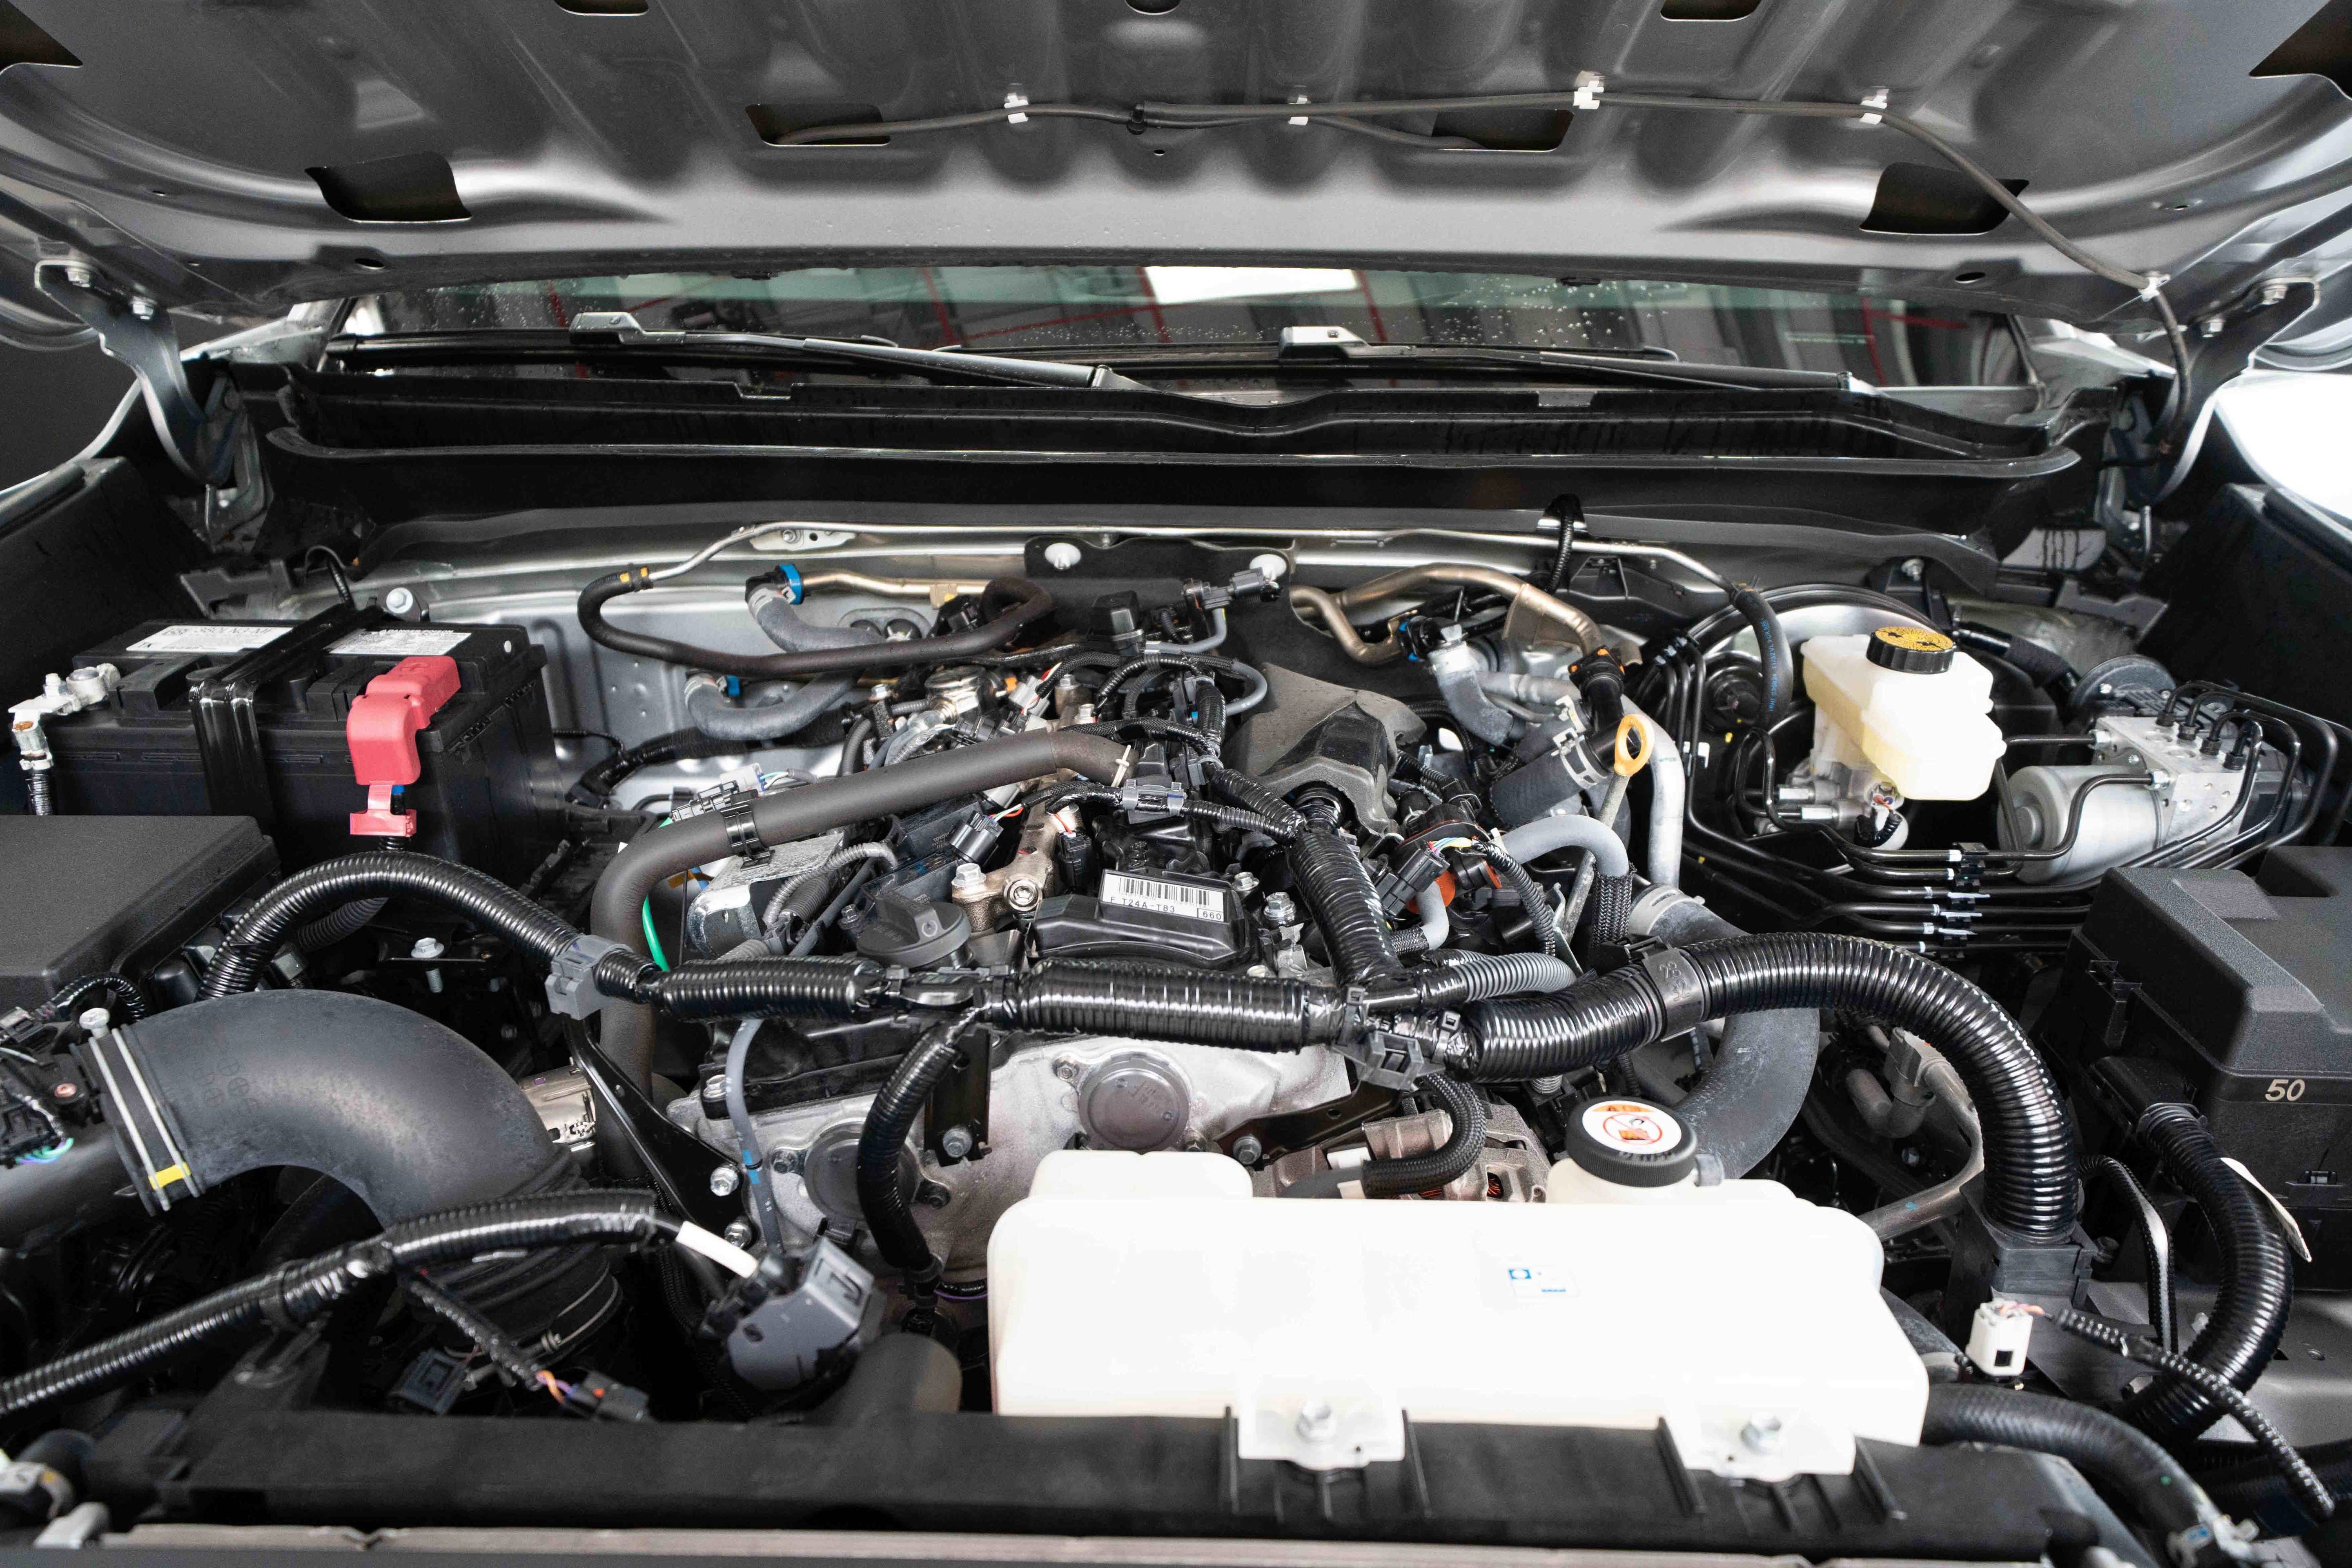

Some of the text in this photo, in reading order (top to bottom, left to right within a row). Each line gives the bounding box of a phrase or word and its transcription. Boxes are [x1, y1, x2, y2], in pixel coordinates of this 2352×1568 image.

[933, 832, 949, 842] TOYOT
[914, 893, 927, 902] YOTA
[1122, 898, 1175, 913] T24A-T83
[1203, 911, 1222, 920] 660
[1659, 960, 1681, 981] 28
[2265, 1079, 2305, 1101] 50
